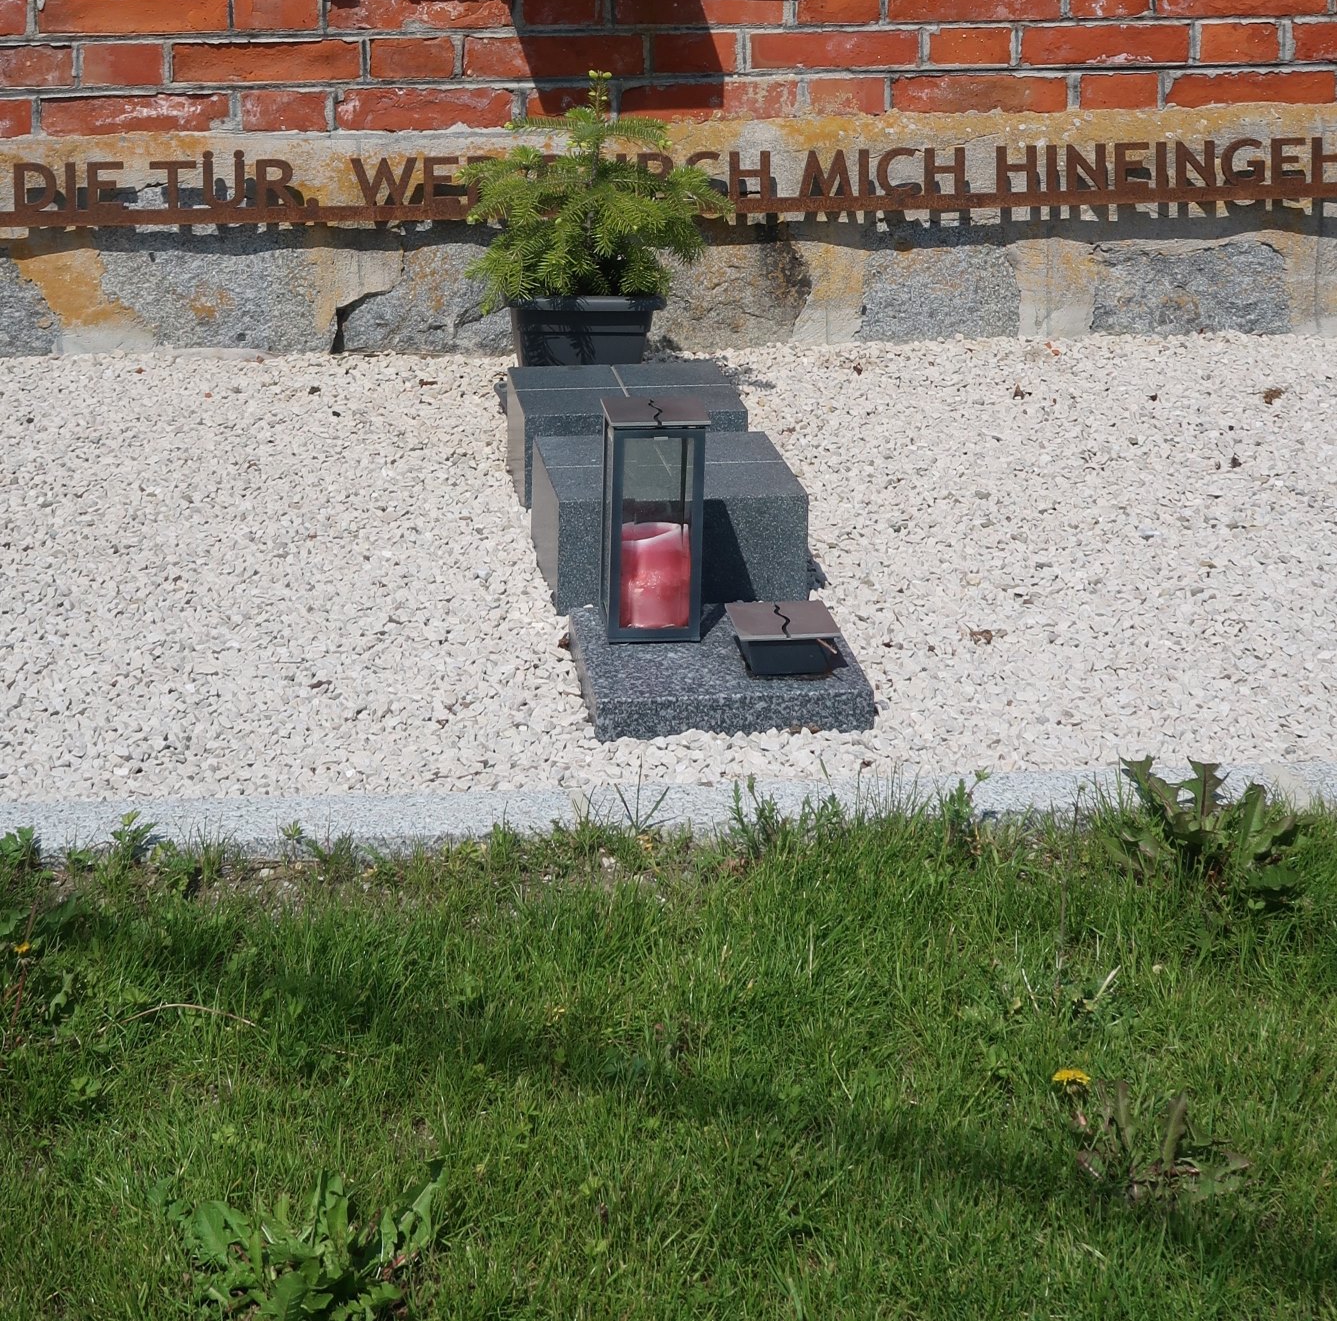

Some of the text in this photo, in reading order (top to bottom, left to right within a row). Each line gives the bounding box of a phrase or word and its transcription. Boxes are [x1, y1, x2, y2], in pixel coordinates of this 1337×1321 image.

[13, 160, 125, 214] DIE
[149, 149, 320, 211] TÜR.
[800, 146, 966, 197] MICH
[995, 136, 1337, 193] HINEINGEH
